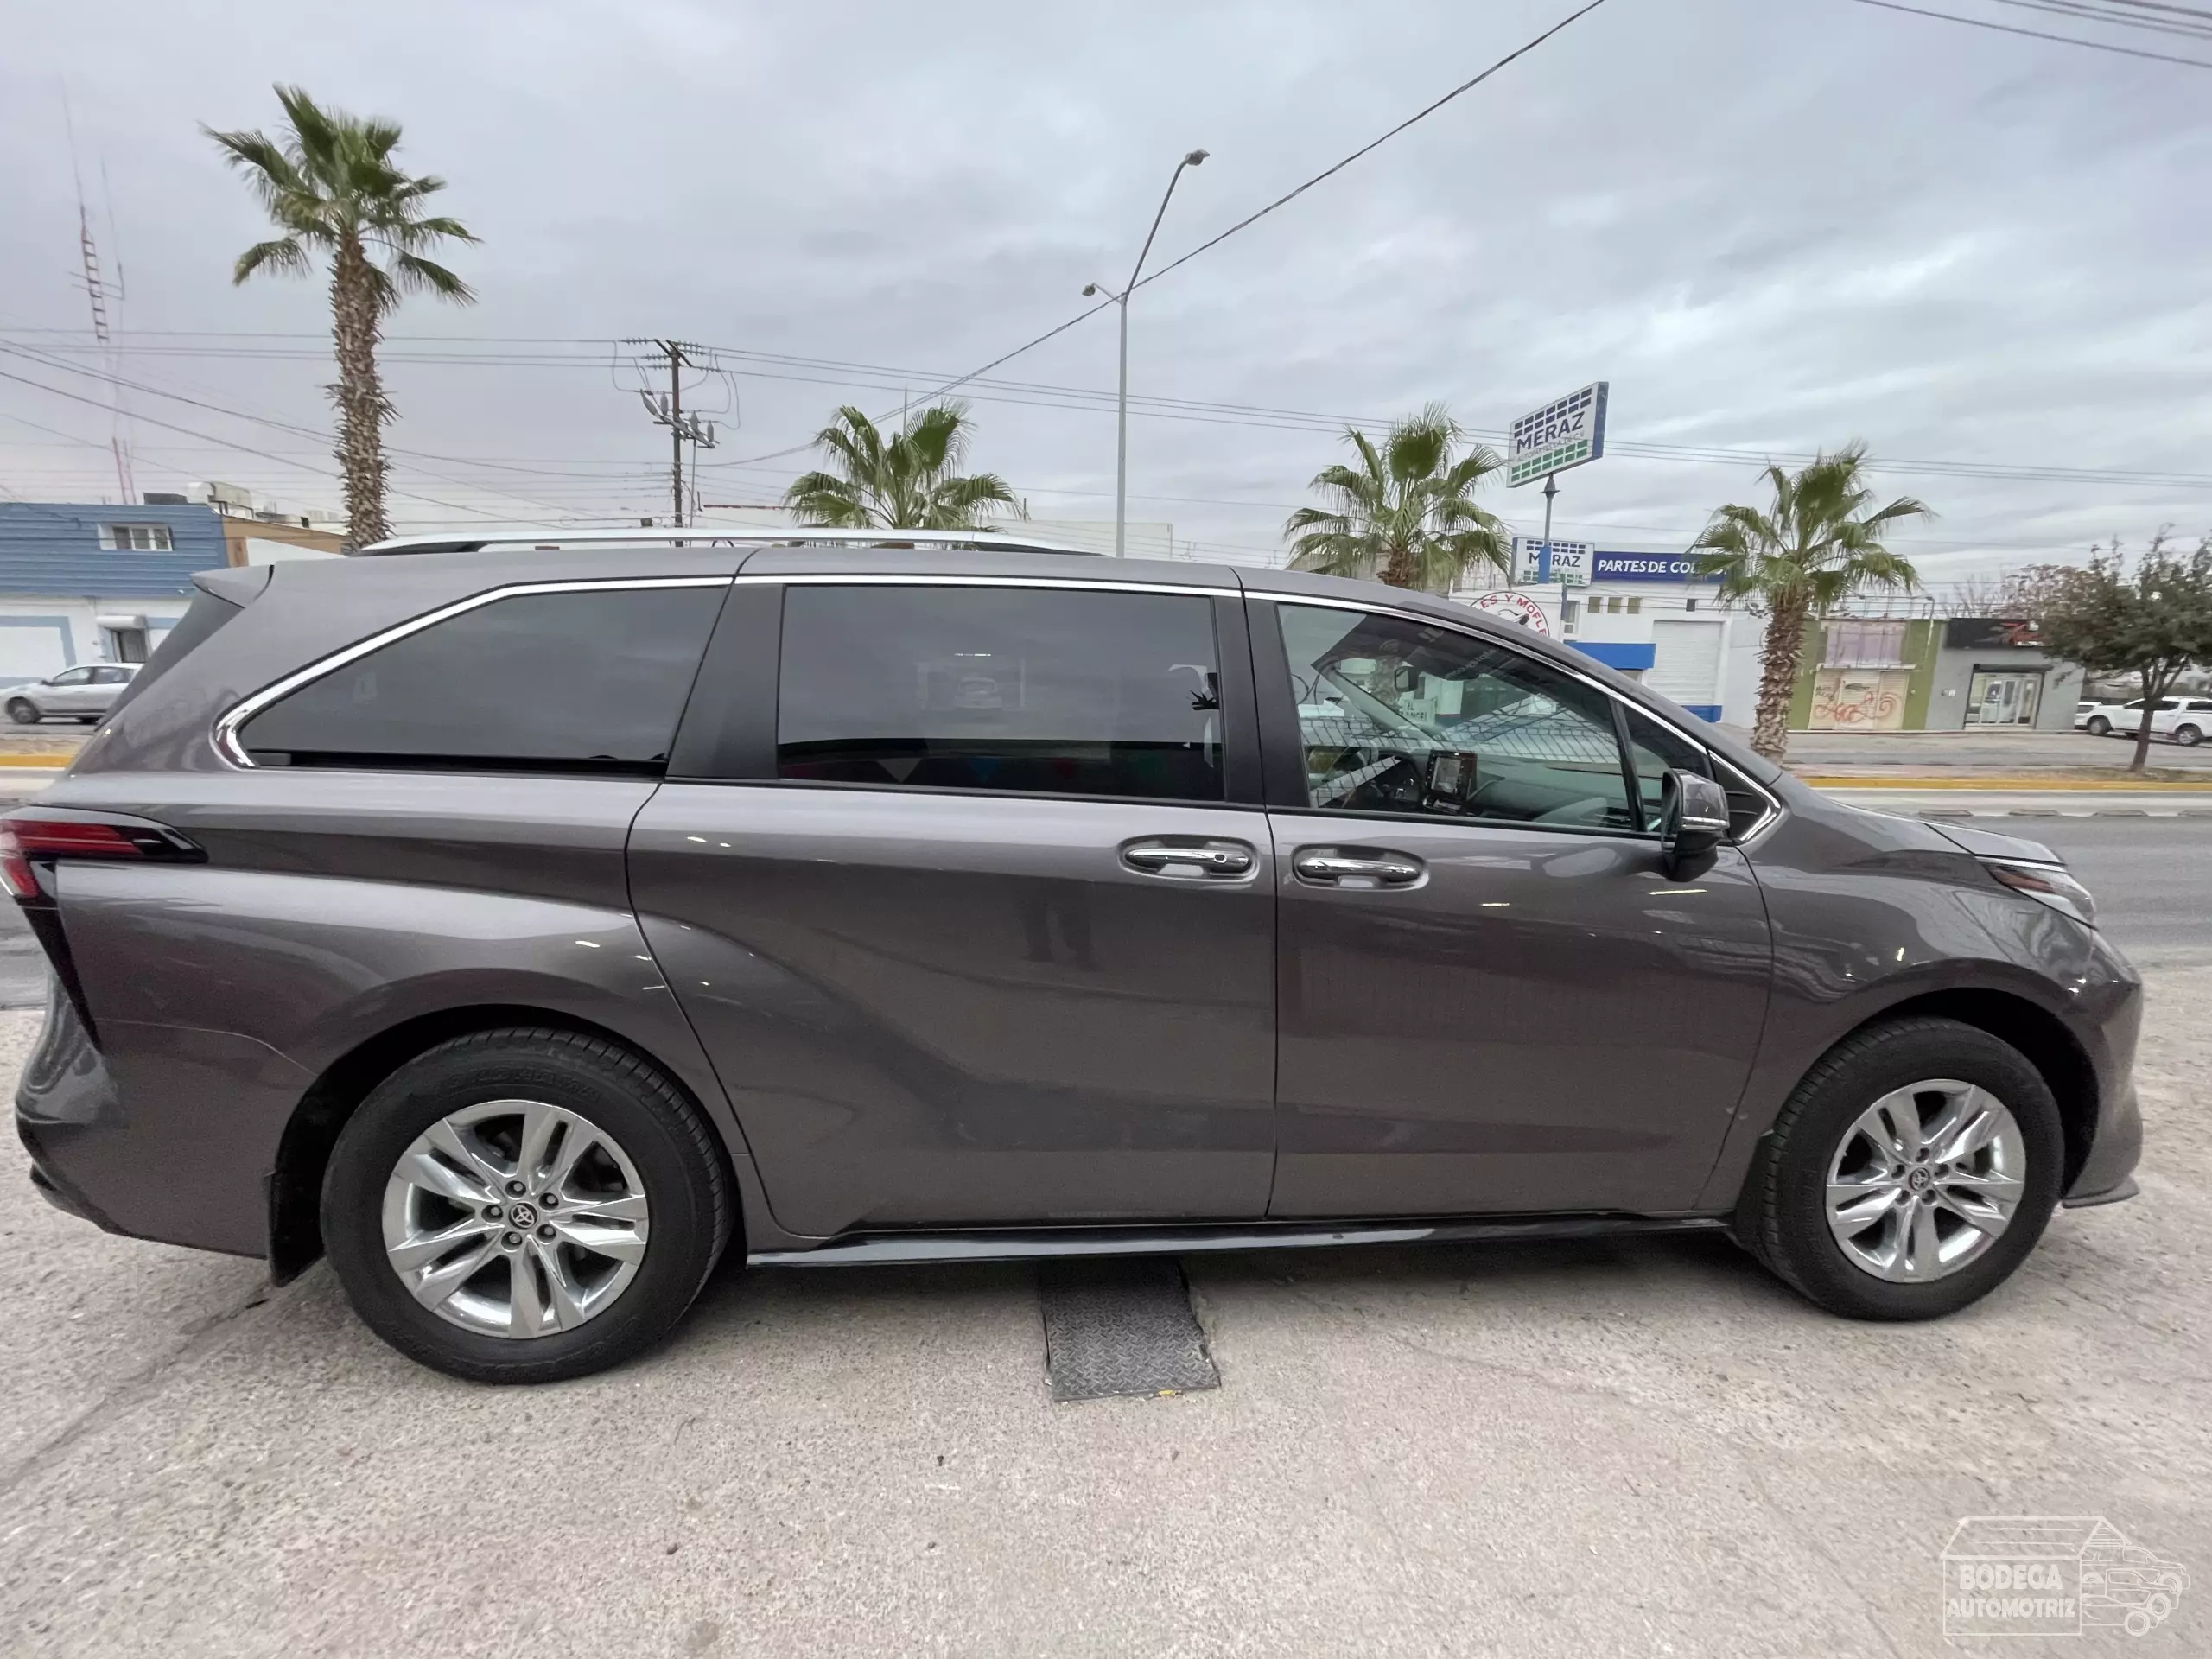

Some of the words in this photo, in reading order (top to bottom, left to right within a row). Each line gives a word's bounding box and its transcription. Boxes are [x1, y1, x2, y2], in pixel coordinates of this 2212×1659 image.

[1516, 411, 1585, 454] MERAZ
[1529, 552, 1580, 568] MRAZ
[1598, 559, 1647, 573] PARTES
[1648, 561, 1667, 574] DE
[1480, 594, 1498, 609] ES
[1505, 594, 1514, 602] Y
